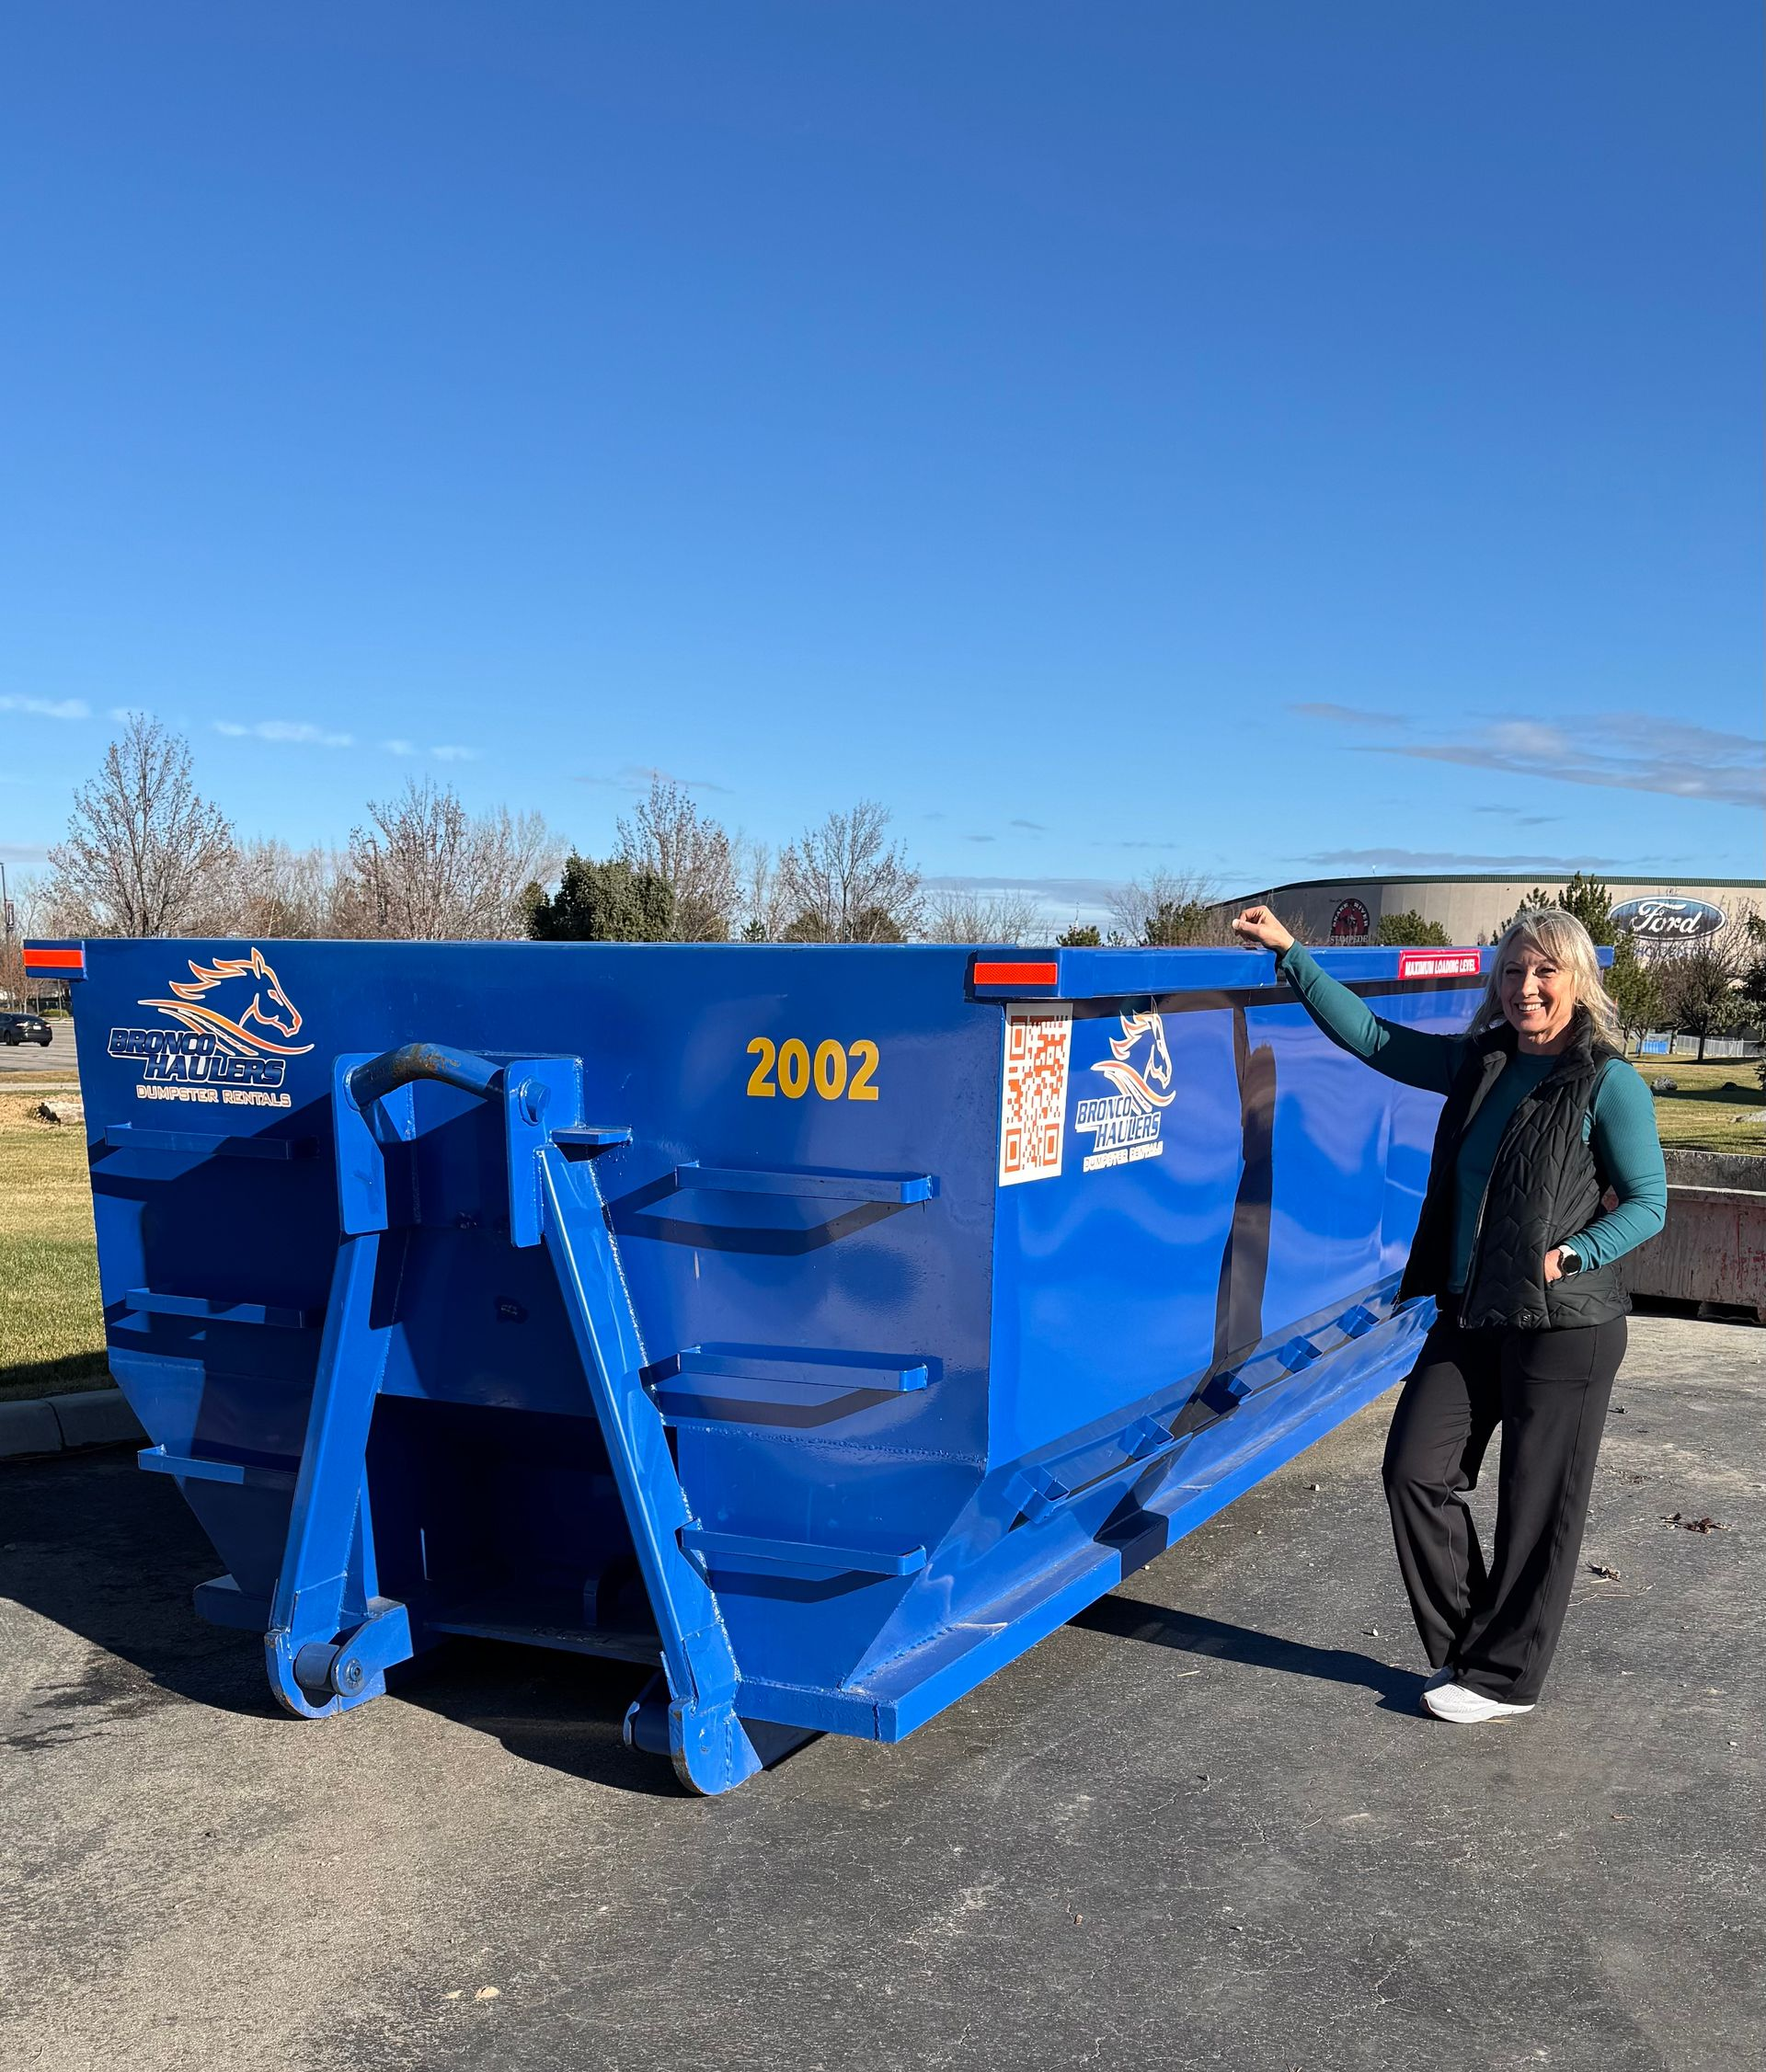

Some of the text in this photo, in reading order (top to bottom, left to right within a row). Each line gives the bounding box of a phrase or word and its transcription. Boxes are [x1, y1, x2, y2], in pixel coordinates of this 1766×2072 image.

[1629, 900, 1703, 933] Ford
[1330, 934, 1369, 944] STAMPEDE
[1405, 958, 1475, 976] MAXIMUM LOADING LEVEL
[109, 1028, 216, 1056] BRONCO
[144, 1056, 285, 1087] HAULERS
[746, 1036, 880, 1101] 2002
[136, 1085, 292, 1107] DUMPSTER RENTALS
[1077, 1096, 1132, 1125] BRONCO
[1095, 1114, 1161, 1150] HAULERS
